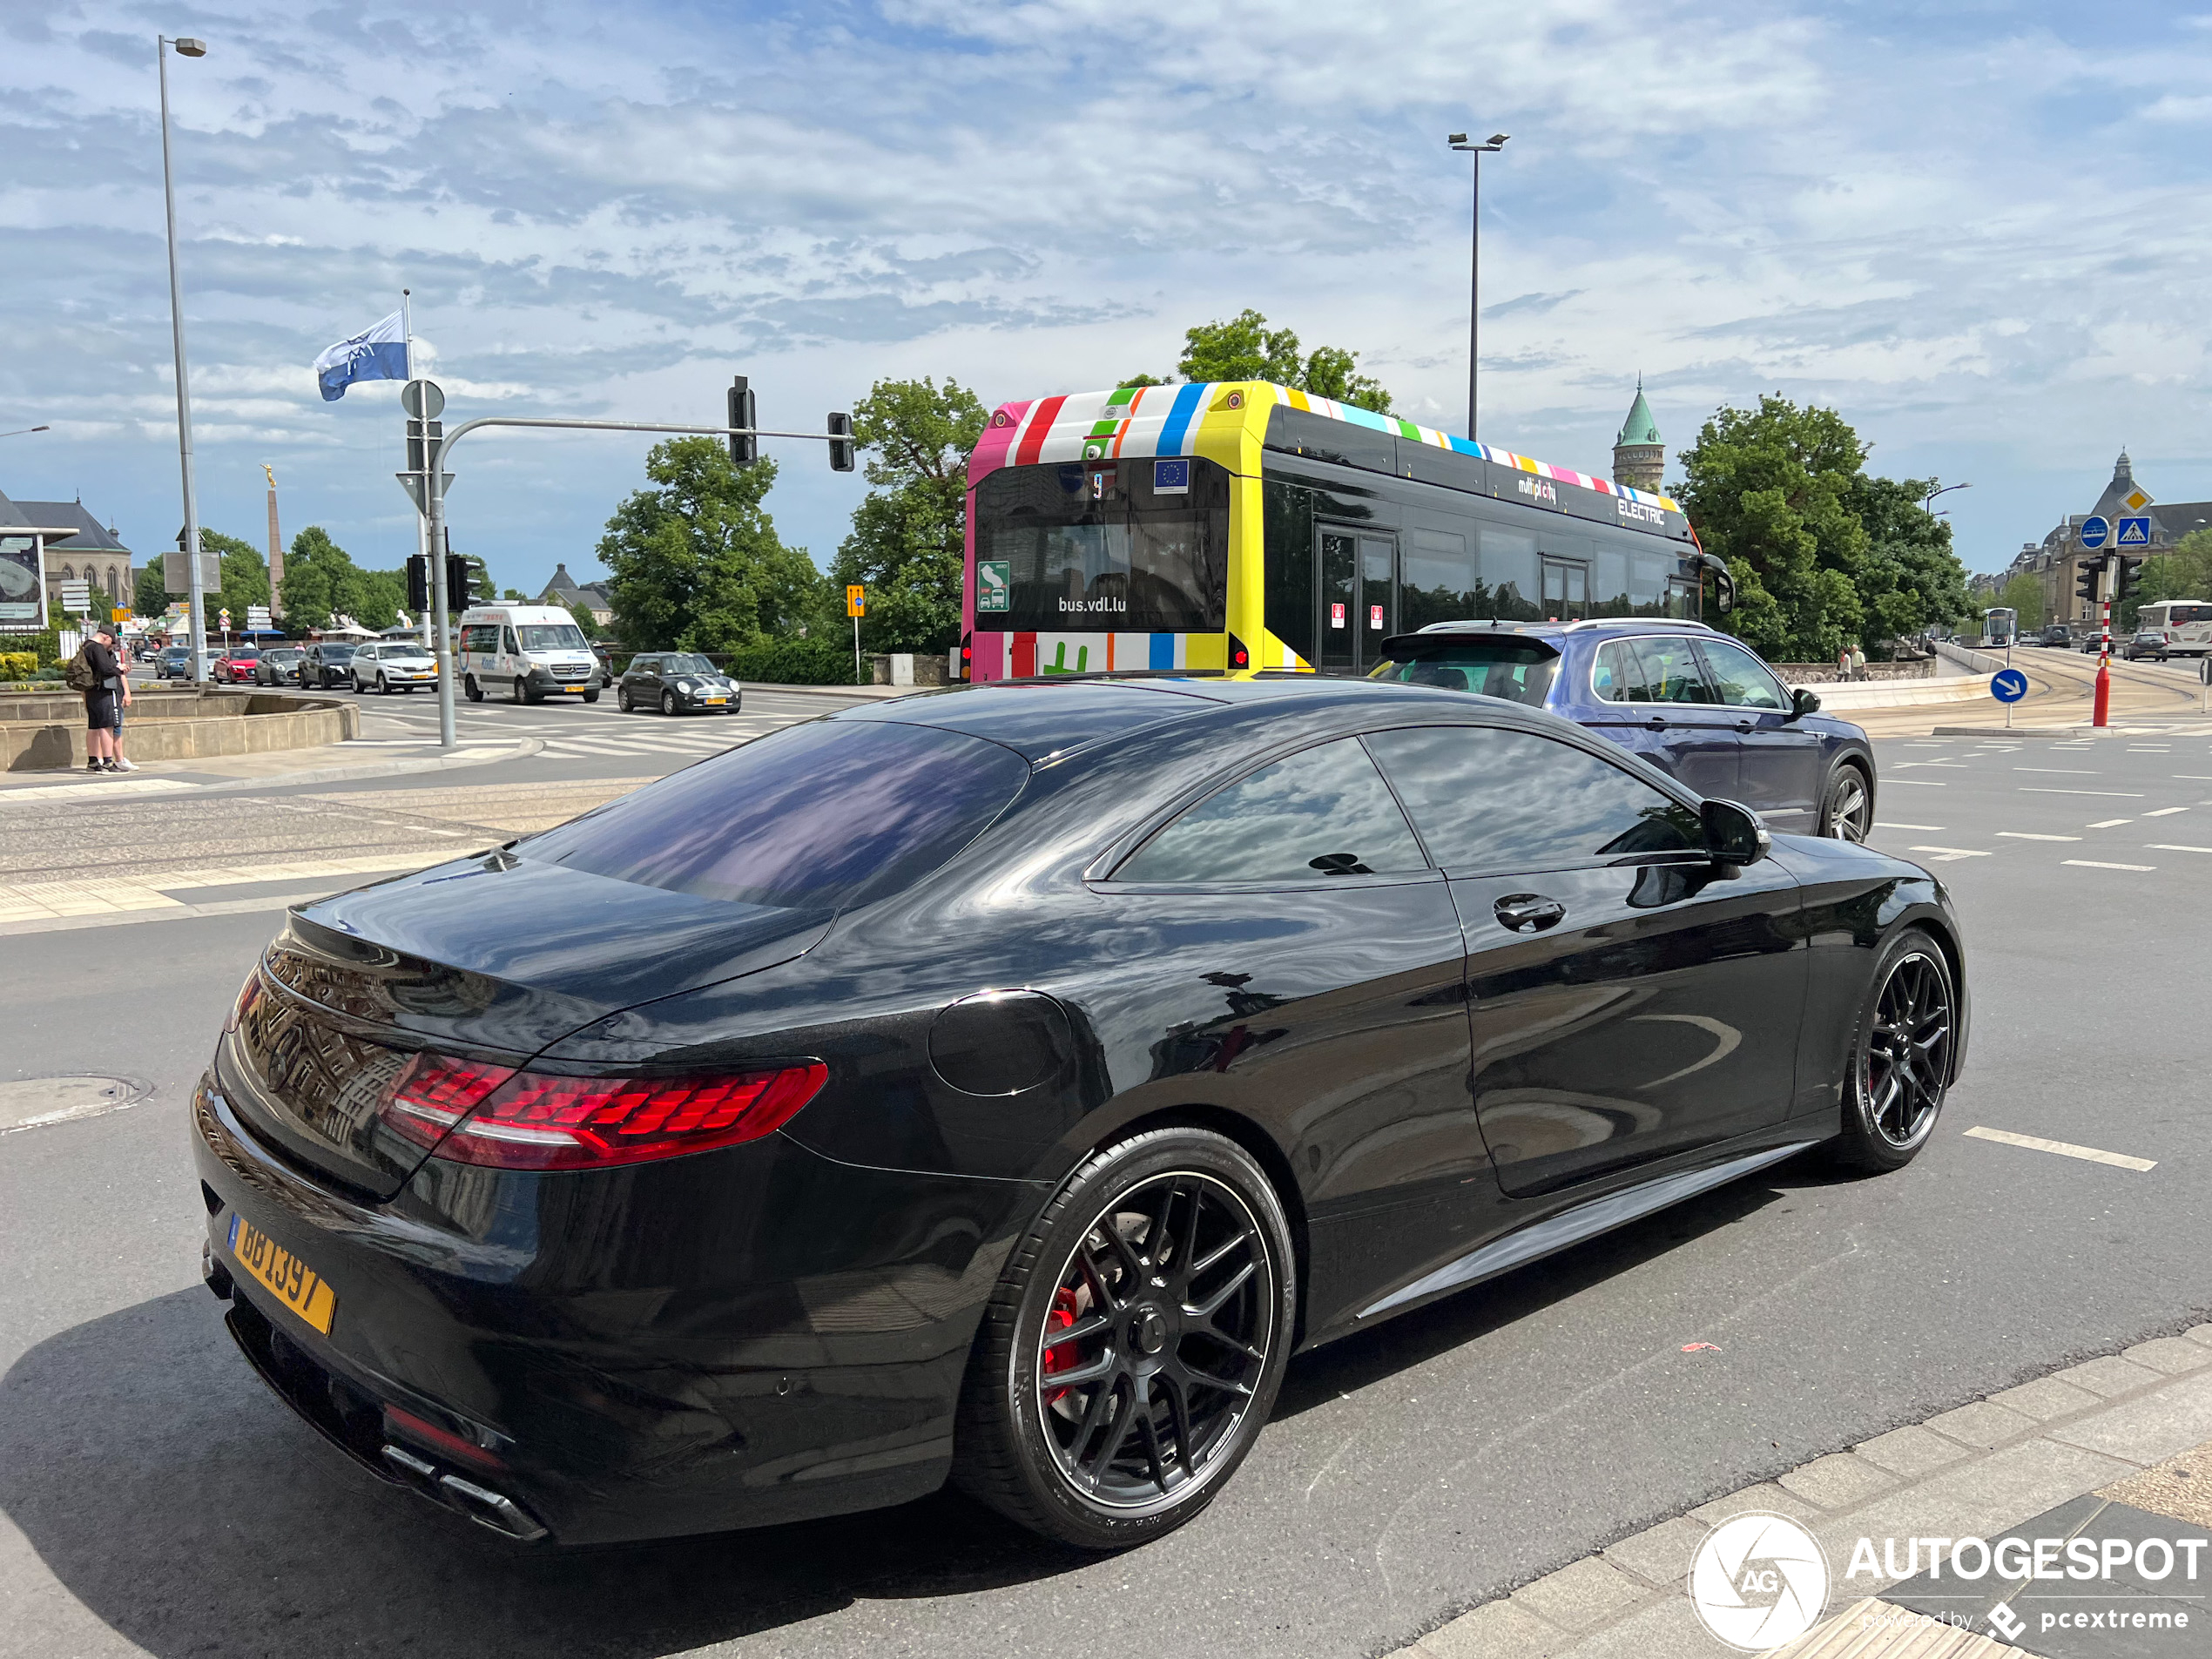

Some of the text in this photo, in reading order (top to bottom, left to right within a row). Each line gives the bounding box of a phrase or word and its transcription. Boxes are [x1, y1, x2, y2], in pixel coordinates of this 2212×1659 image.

[1093, 473, 1103, 499] 9
[1518, 476, 1556, 505] multiplicity
[1617, 498, 1665, 525] ELECTRIC
[1058, 596, 1126, 612] bus.vdl.lu
